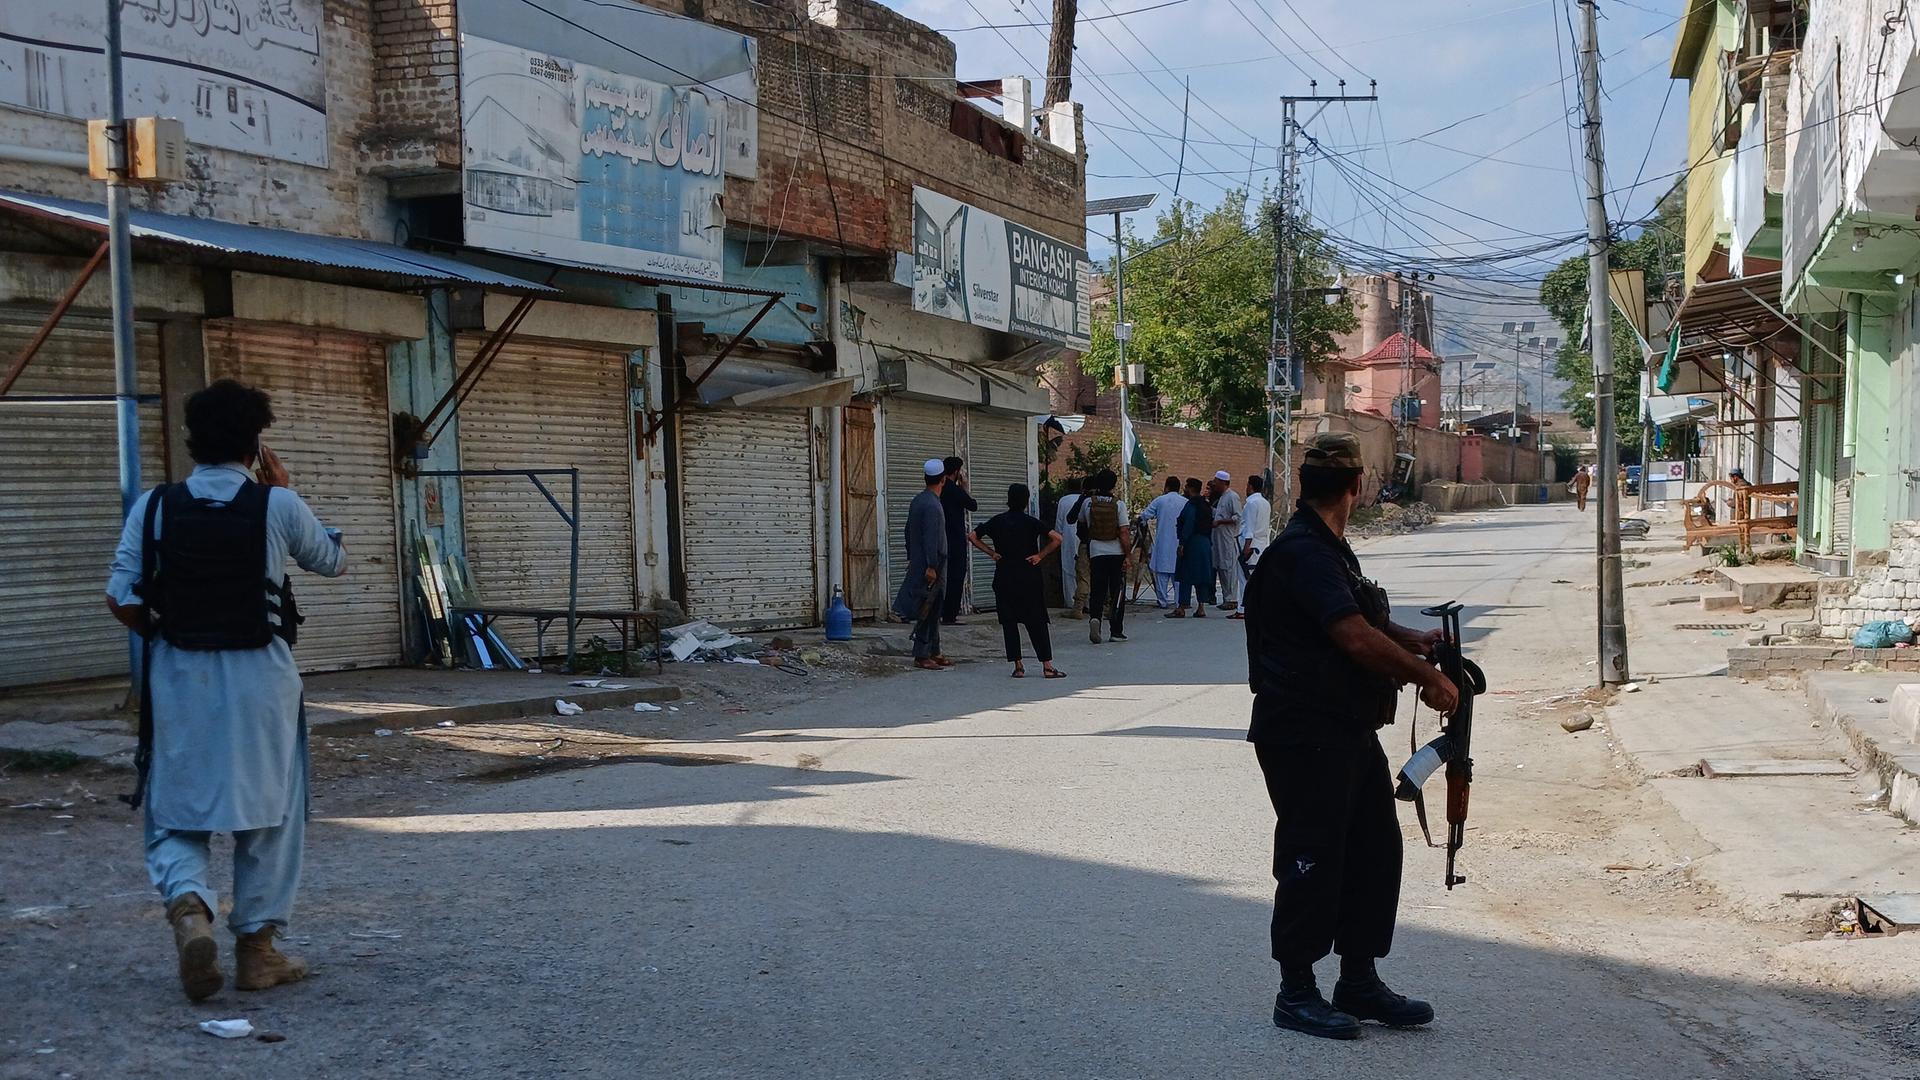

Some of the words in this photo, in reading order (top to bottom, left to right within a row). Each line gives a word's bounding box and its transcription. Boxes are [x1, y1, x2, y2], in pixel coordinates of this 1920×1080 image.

[1012, 231, 1072, 281] BANGASH
[1019, 267, 1049, 291] INTERIOR
[1048, 276, 1068, 297] KOHAT
